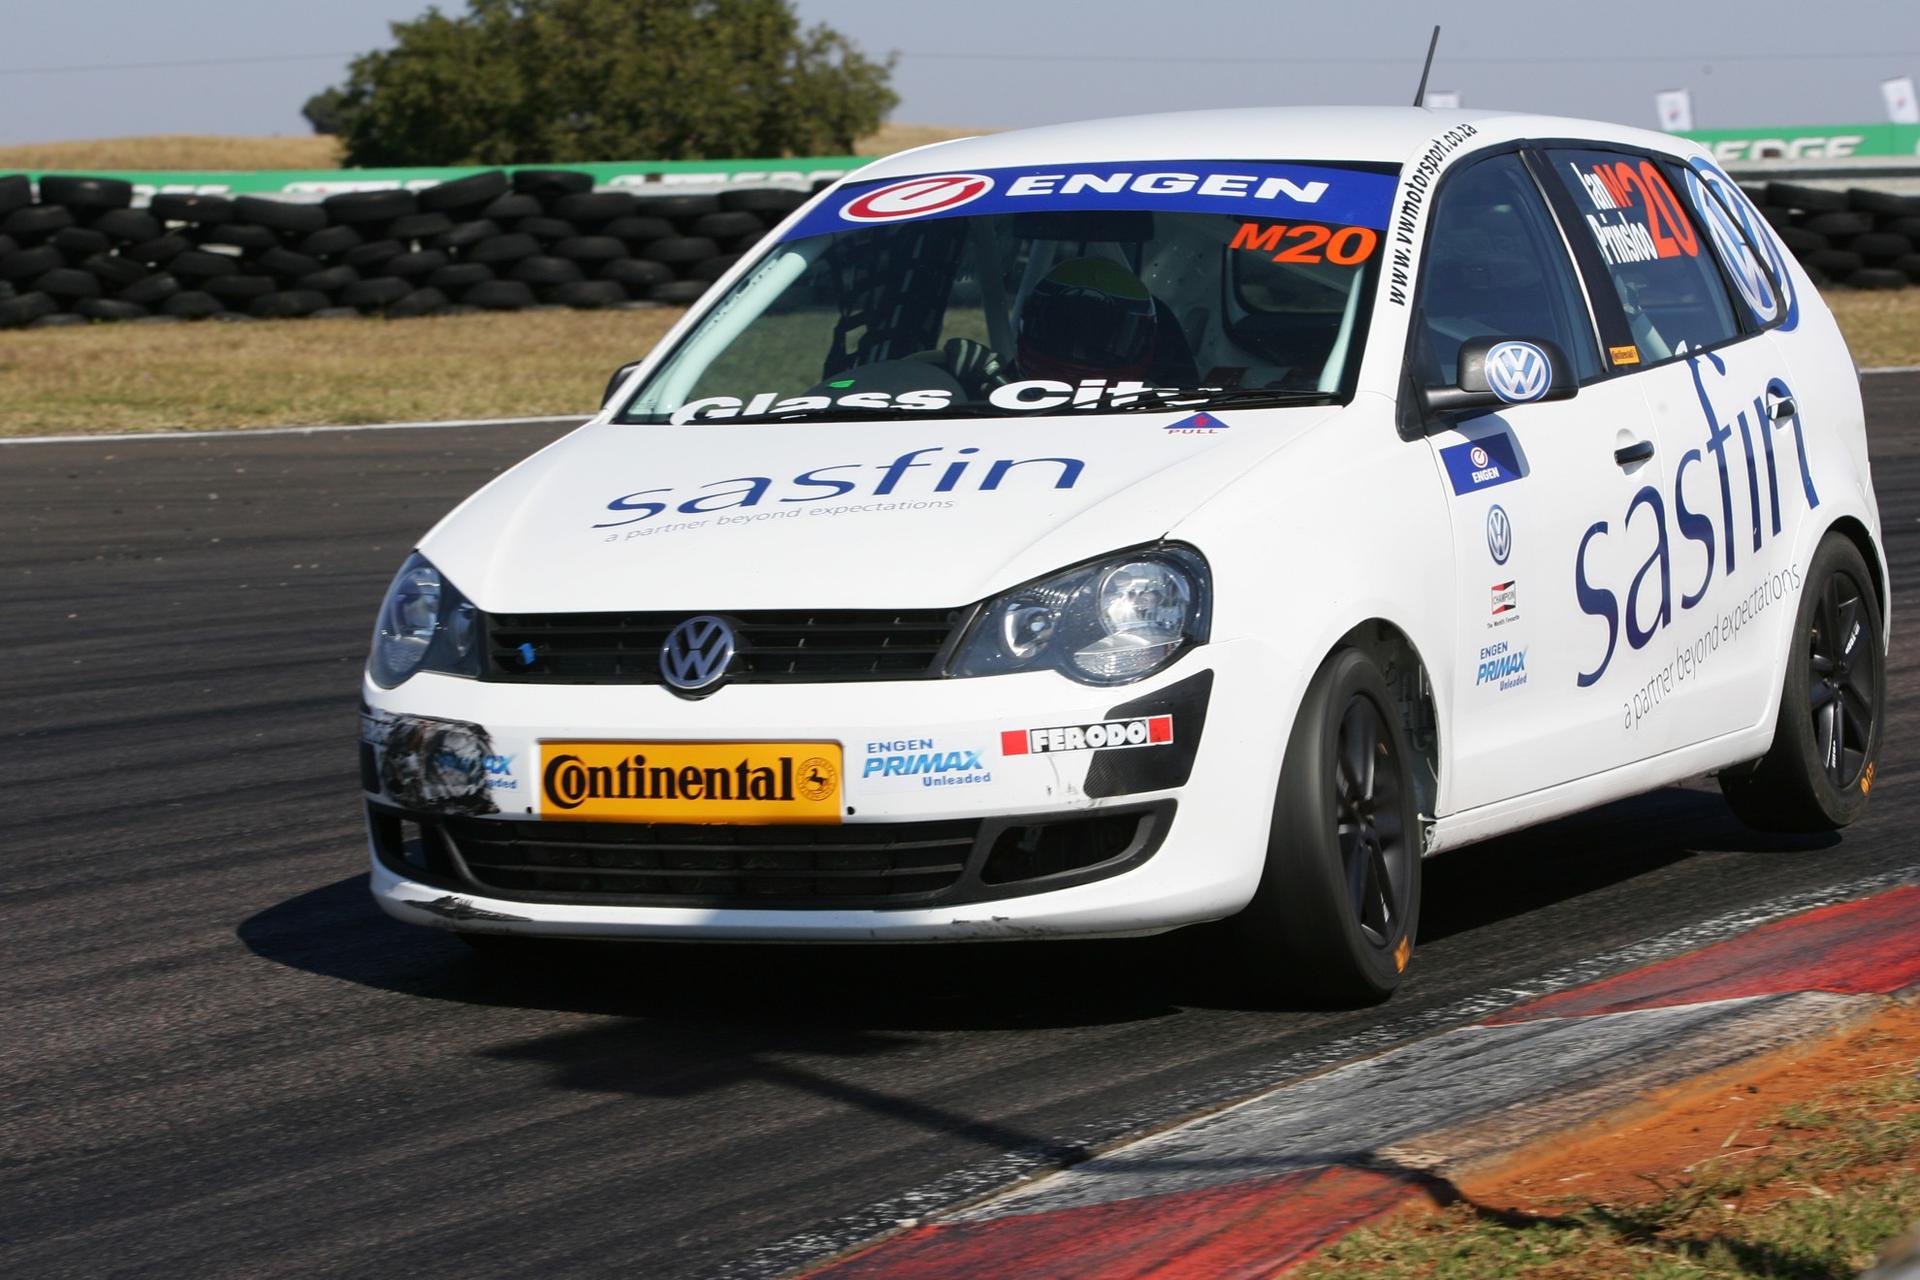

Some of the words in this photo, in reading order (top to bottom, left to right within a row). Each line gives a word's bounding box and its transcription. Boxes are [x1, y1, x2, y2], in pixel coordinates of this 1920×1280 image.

[1005, 172, 1330, 204] ENGEN
[1389, 123, 1478, 307] www.vwmotorsport.co.za
[1592, 160, 1699, 259] M20
[1228, 222, 1377, 266] M20
[1585, 211, 1658, 265] Prinsloo
[1167, 428, 1219, 436] PULL
[591, 447, 1086, 529] sasfin
[1471, 466, 1500, 484] ENGEN
[604, 533, 618, 543] a
[624, 519, 710, 542] partner
[715, 506, 802, 529] beyond
[808, 499, 954, 518] expectations
[1575, 340, 1820, 688] sasfin
[1480, 641, 1508, 660] ENGEN
[1623, 702, 1632, 730] a
[1634, 661, 1674, 731] partner
[1676, 613, 1720, 681] beyond
[1721, 563, 1801, 642] expectations
[1476, 648, 1527, 687] PRIMAX
[1499, 672, 1528, 692] Unleaded
[867, 738, 933, 754] ENGEN
[1030, 721, 1148, 752] FERODO
[543, 754, 795, 810] Continental
[862, 749, 984, 779] PRIMAX
[922, 771, 992, 787] Unleaded
